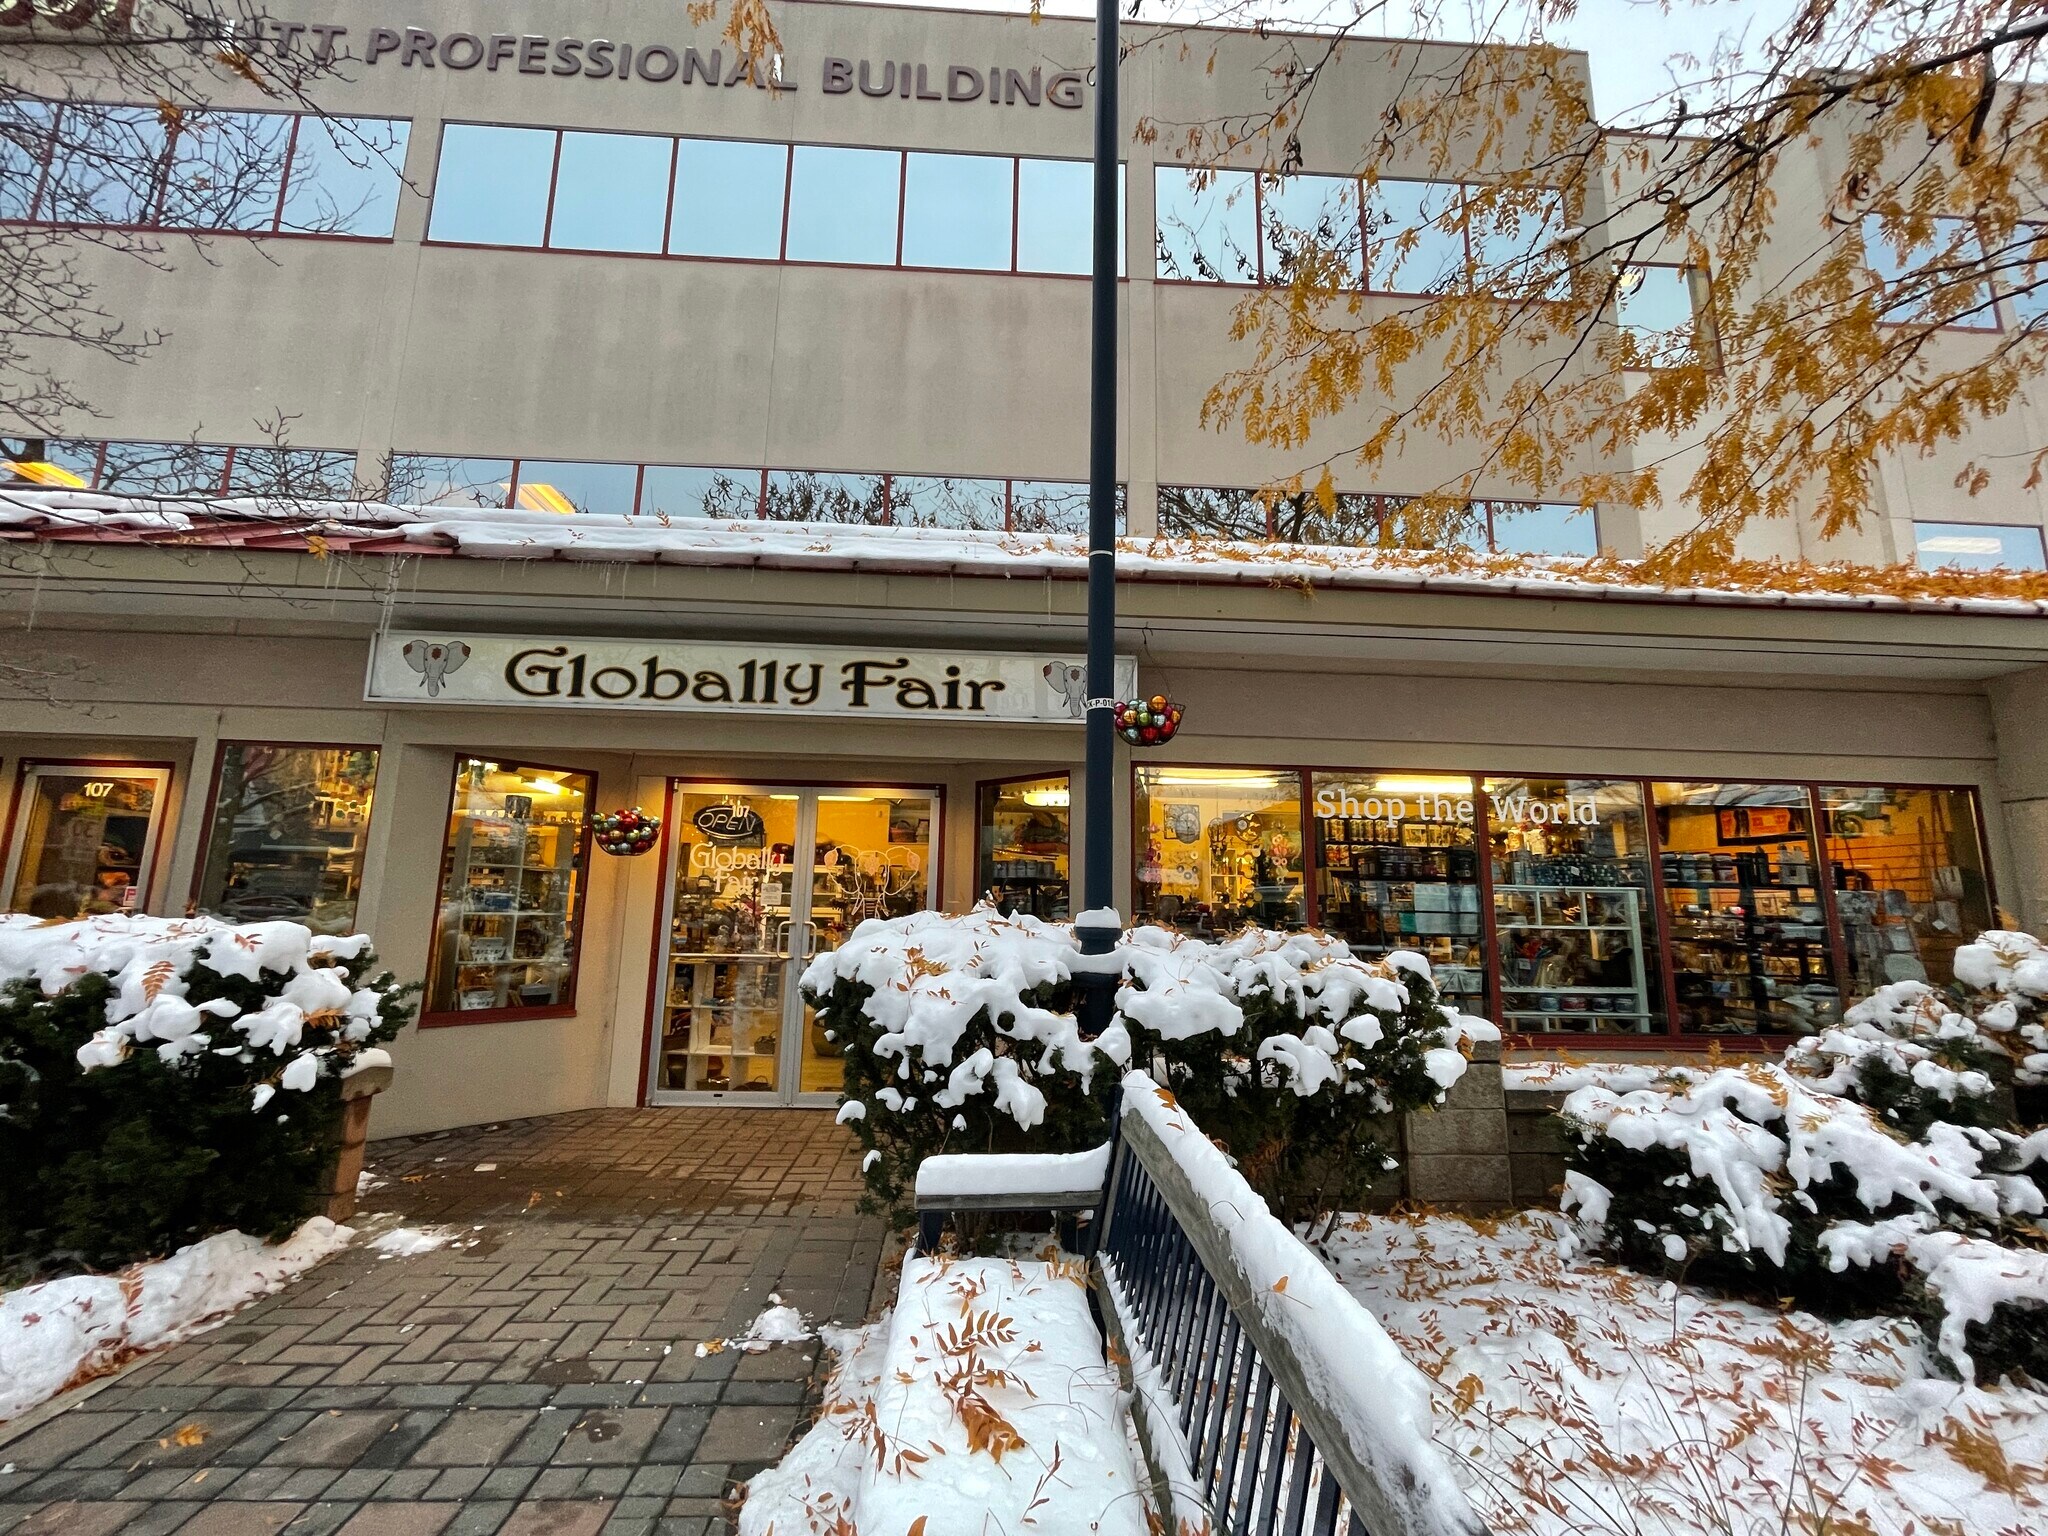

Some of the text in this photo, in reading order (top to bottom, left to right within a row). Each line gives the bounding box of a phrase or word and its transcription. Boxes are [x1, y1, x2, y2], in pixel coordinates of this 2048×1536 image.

[365, 27, 798, 91] PROFESSIONAL
[822, 57, 1084, 109] BUILDING
[504, 646, 1006, 711] Globally Fair
[84, 782, 114, 797] 107
[698, 812, 756, 831] OPEN
[732, 804, 750, 818] 107
[1316, 789, 1600, 828] Shop the World
[690, 841, 785, 876] Globally
[713, 866, 759, 893] Fair
